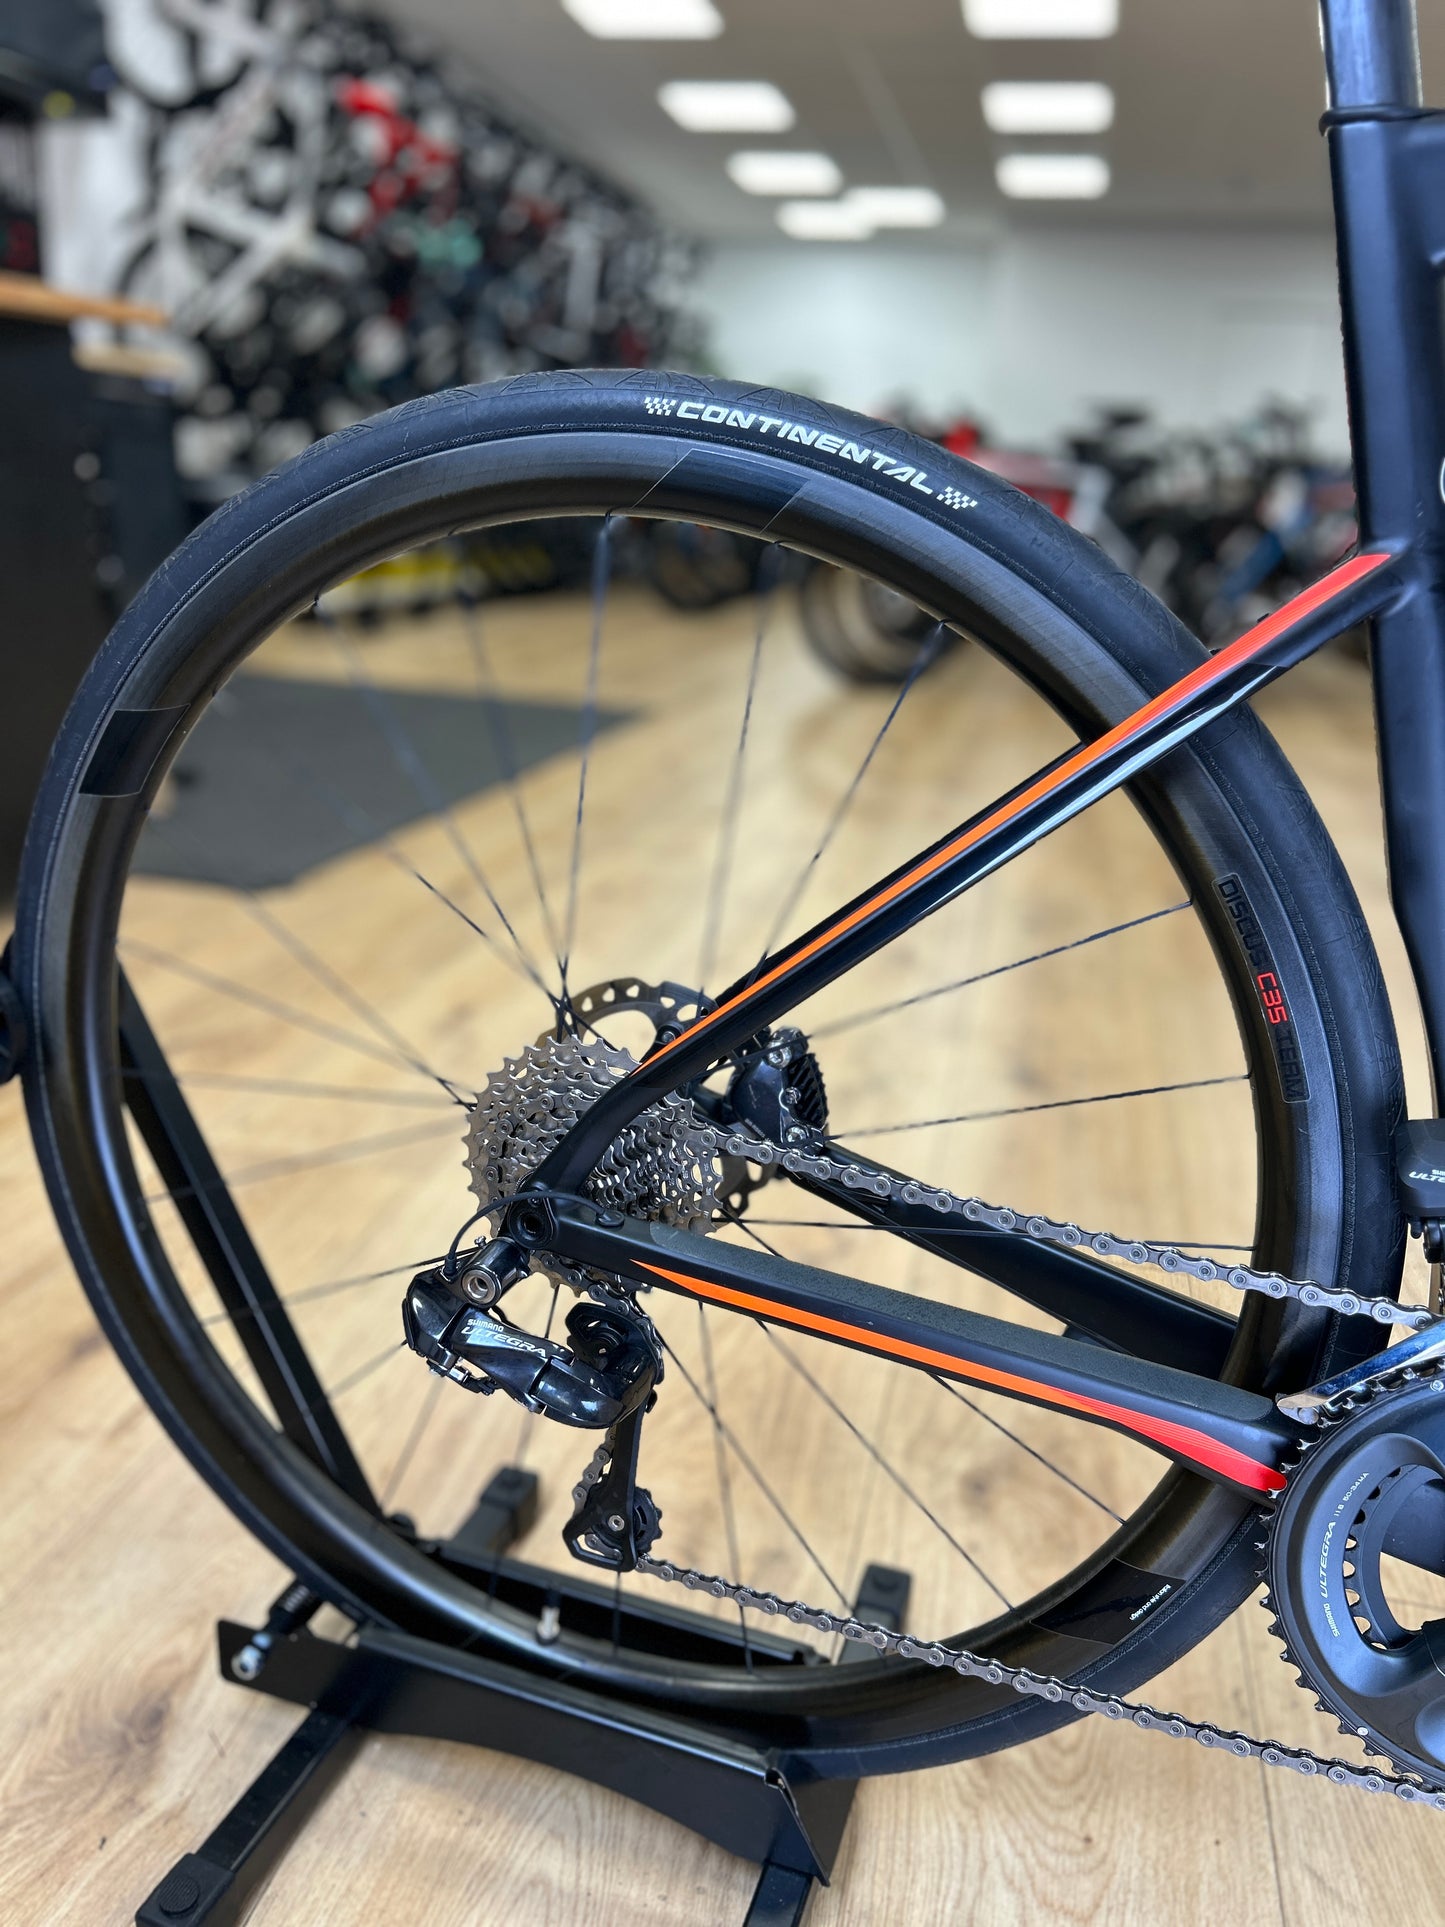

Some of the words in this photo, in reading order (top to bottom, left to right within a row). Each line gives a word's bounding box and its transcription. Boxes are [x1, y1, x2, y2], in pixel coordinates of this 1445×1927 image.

[676, 401, 933, 494] CONTINENTAL
[1218, 878, 1269, 967] DISCUS
[1256, 972, 1288, 1024] C35
[1275, 1029, 1304, 1099] TEAM
[460, 1326, 546, 1357] ULTEGRA
[467, 1318, 504, 1332] SHIMANO
[1319, 1521, 1337, 1598] ULTEGRA
[1323, 1603, 1341, 1637] SHIMANO
